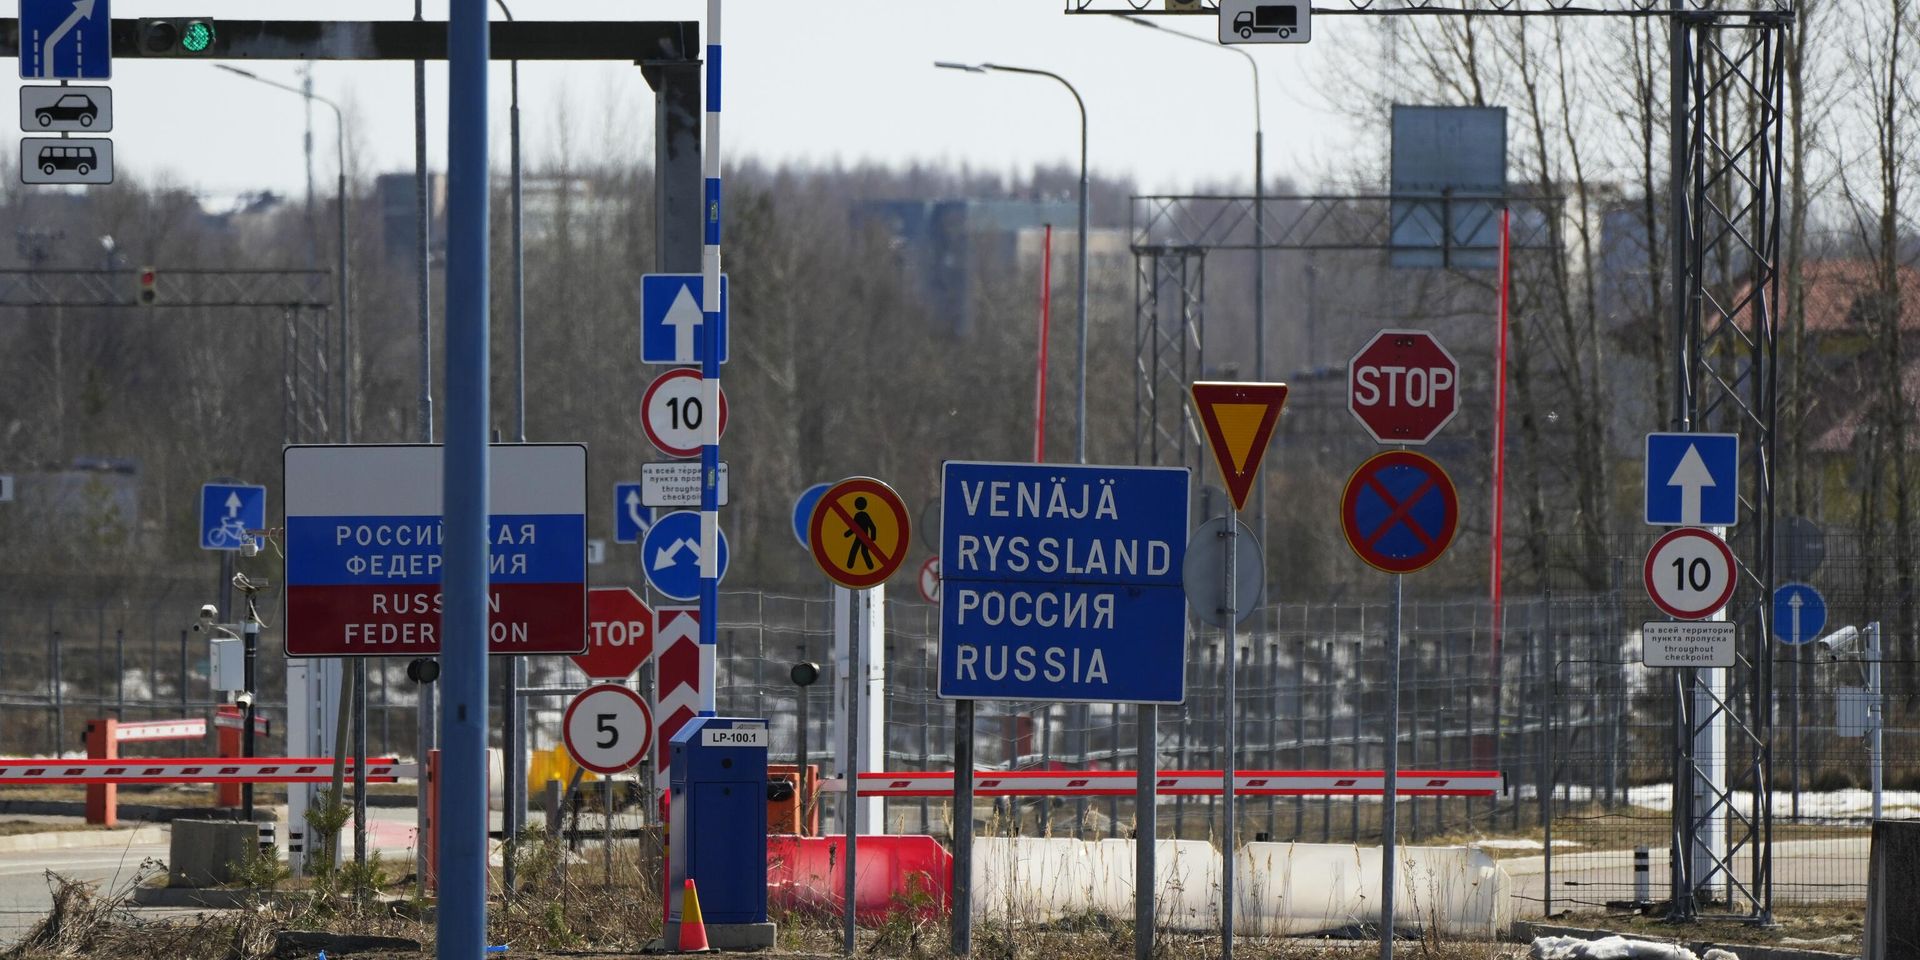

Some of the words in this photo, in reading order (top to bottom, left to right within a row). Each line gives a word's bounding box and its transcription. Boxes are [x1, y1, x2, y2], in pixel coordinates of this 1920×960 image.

[1355, 366, 1453, 408] STOP
[666, 397, 702, 430] 10
[662, 486, 701, 494] througho
[960, 476, 1118, 520] VENÄJÄ
[336, 521, 536, 546] РОССИАЯ
[346, 554, 527, 578] ФЕДЕРИЯ
[957, 535, 1171, 576] RYSSLAND
[1672, 557, 1711, 592] 10
[372, 593, 500, 614] RUSSN
[957, 590, 1115, 629] РОССИЯ
[344, 622, 528, 644] FEDERON
[588, 621, 645, 646] TOP
[1682, 627, 1734, 635] территории
[1664, 646, 1714, 654] throughout
[1665, 654, 1714, 662] checkpoint
[956, 644, 1108, 684] RUSSIA
[596, 713, 619, 749] 5
[712, 733, 756, 742] LP-100.1
